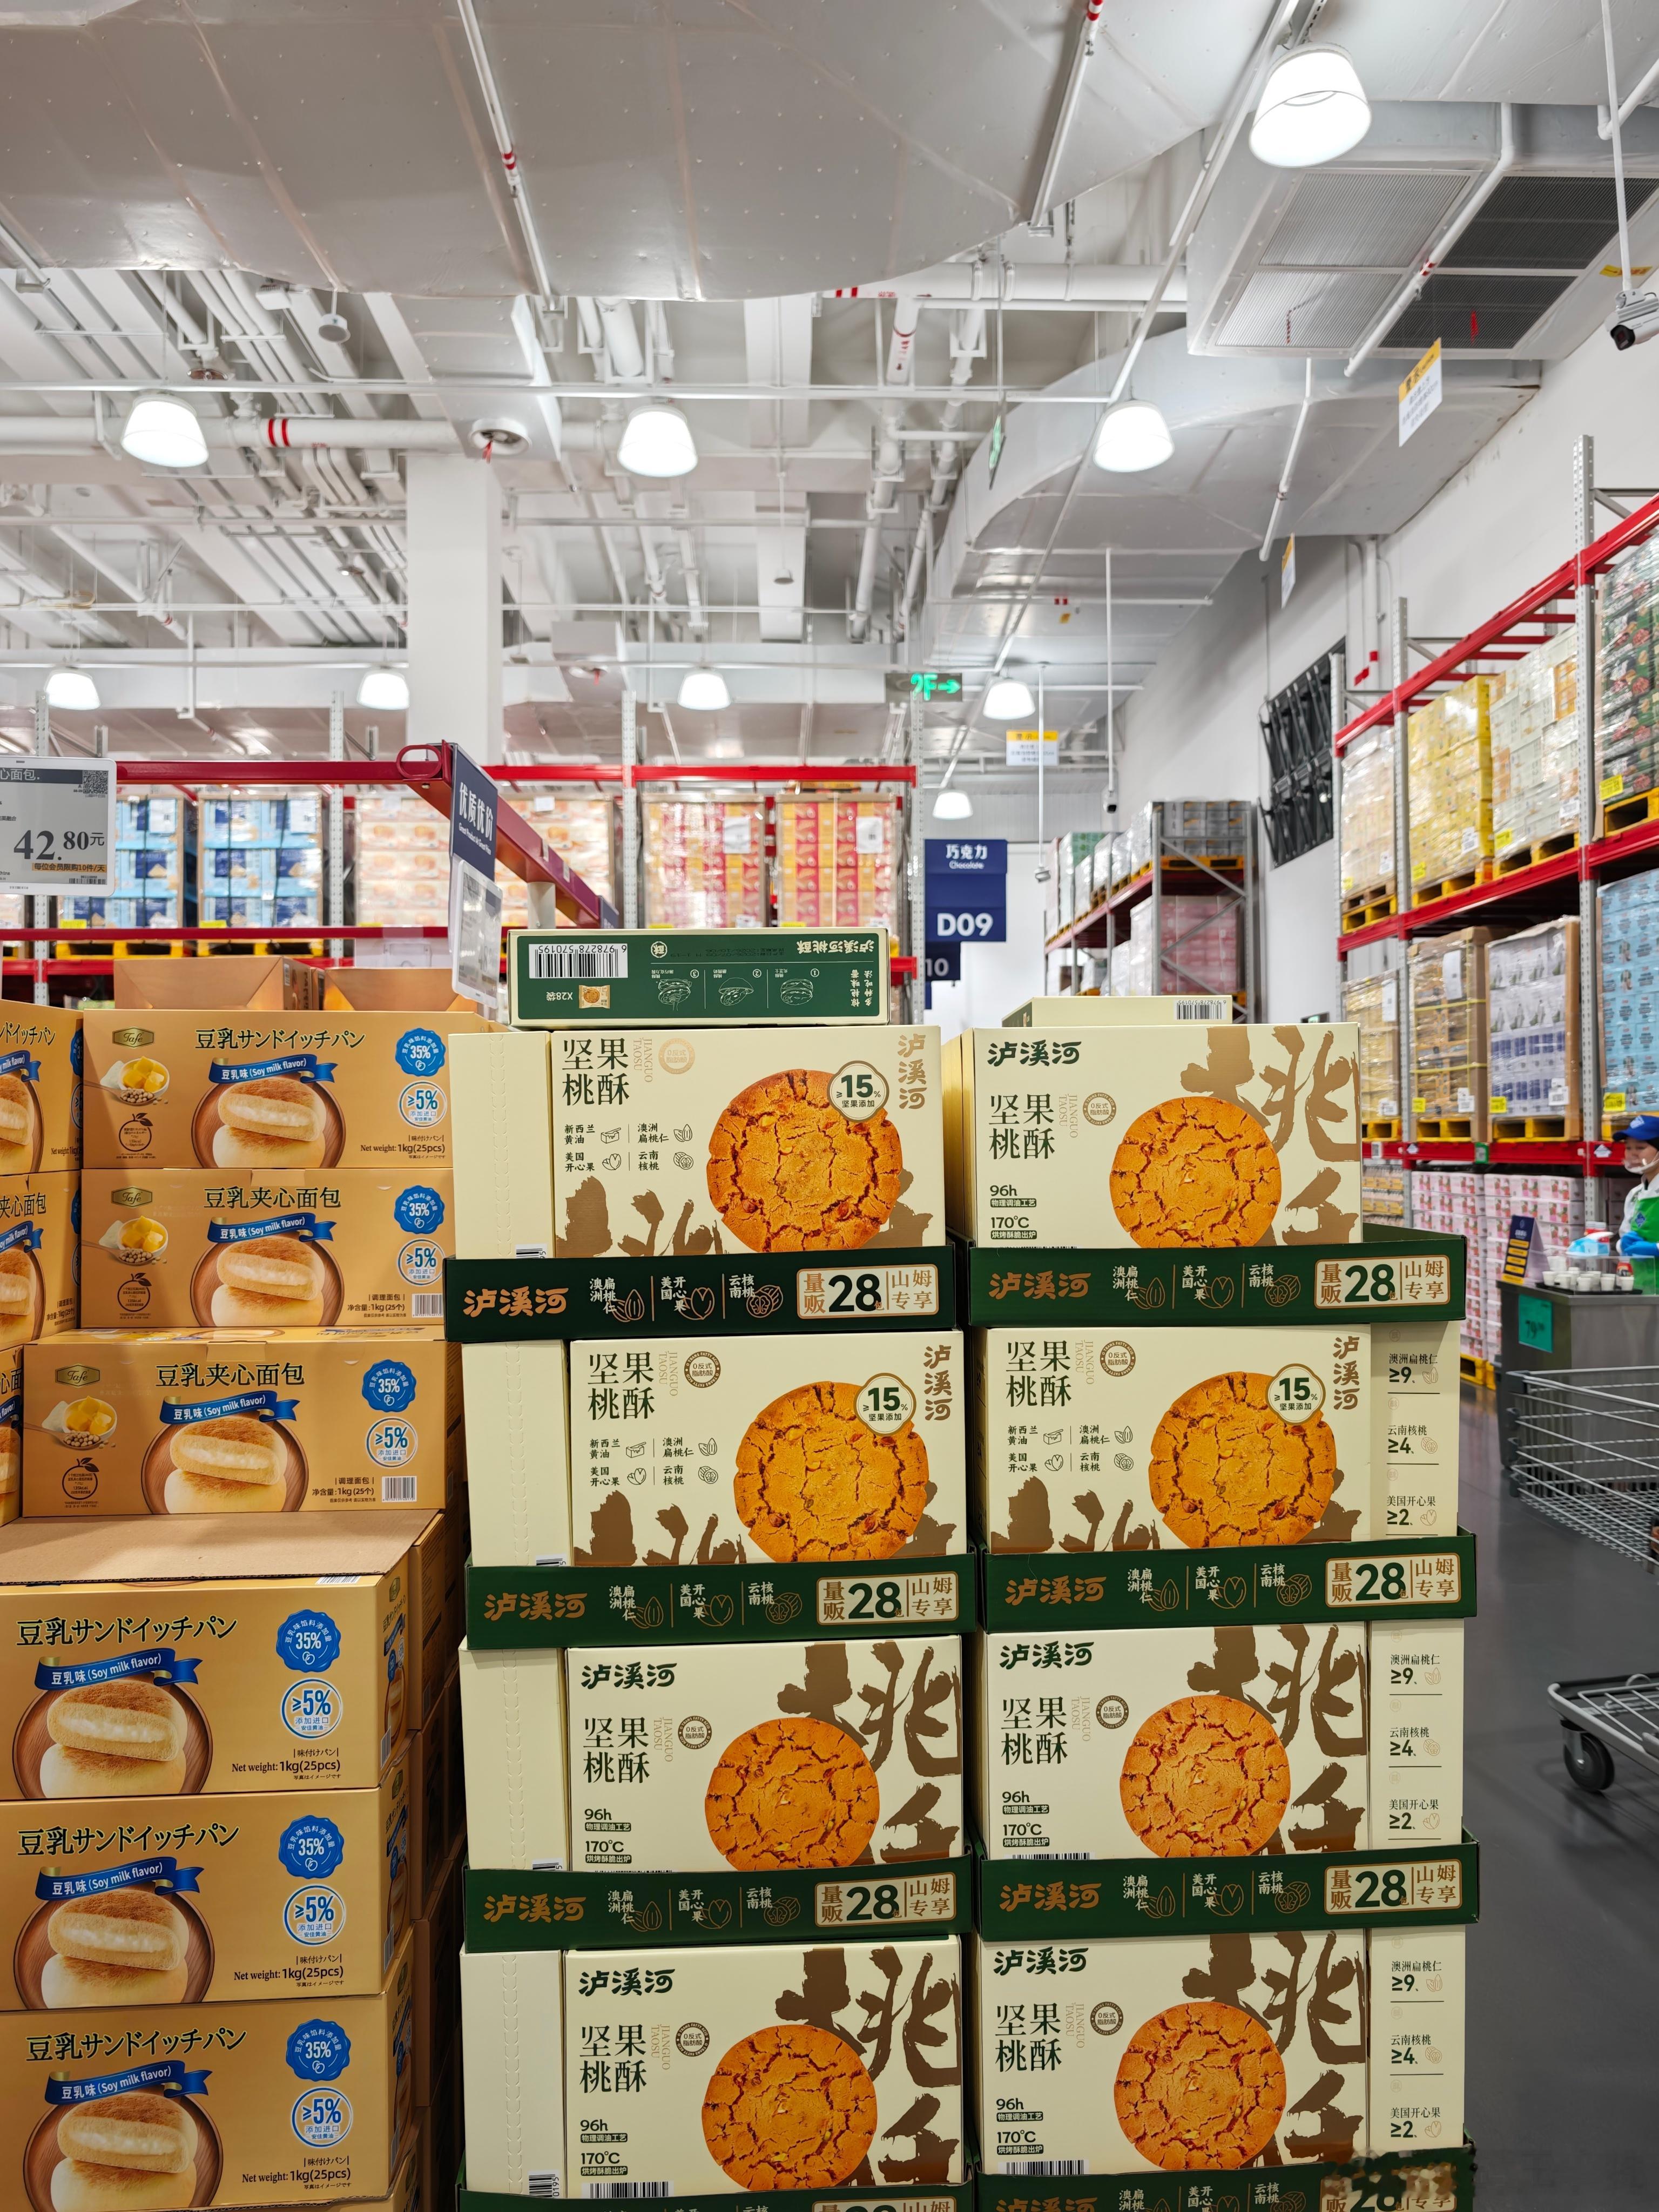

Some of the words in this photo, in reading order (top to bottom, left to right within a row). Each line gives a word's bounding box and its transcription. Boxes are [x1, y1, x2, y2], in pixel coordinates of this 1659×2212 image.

[460, 782, 493, 841] 优质优价
[946, 844, 988, 860] 巧克力
[34, 863, 105, 872] 每位会员限购10件/天
[949, 860, 984, 869] Chocolate
[937, 913, 994, 936] D09
[653, 945, 664, 955] 酥
[797, 940, 874, 954] 泸溪河桃酥
[546, 992, 572, 1001] X28袋
[850, 969, 860, 1007] 惊艳味蕾
[864, 970, 873, 1006] 多种吃法
[194, 1028, 366, 1050] 豆乳サンドイッチパン
[410, 1046, 430, 1059] 35%
[562, 1038, 629, 1071] 坚果
[633, 1038, 642, 1071] TAOSU
[643, 1037, 653, 1083] JIANGUO
[987, 1040, 1082, 1067] 泸溪河
[898, 1034, 927, 1109] 泸溪河
[408, 1090, 438, 1110] ≥5%
[562, 1073, 630, 1107] 桃酥
[842, 1100, 875, 1108] 坚果添加
[989, 1092, 1055, 1127] 坚果
[373, 1144, 396, 1154] weight:
[398, 1144, 445, 1154] 1kg(25pcs)
[989, 1127, 1055, 1161] 桃酥
[203, 1186, 341, 1210] 豆乳夹心面包
[989, 1184, 1017, 1198] 96h
[991, 1199, 1036, 1207] 物理调油工艺
[409, 1203, 430, 1216] 35%
[991, 1230, 1037, 1239] 烘烤酥脆出炉
[892, 1270, 932, 1290] 山姆
[989, 1271, 1091, 1300] 泸溪河
[1345, 1264, 1395, 1303] 28
[462, 1285, 569, 1318] 泸溪河
[804, 1273, 825, 1315] 量贩
[828, 1273, 881, 1313] 28
[892, 1292, 933, 1311] 专享
[659, 1351, 667, 1385] TAOSU
[1005, 1339, 1071, 1373] 坚果
[1388, 1353, 1439, 1365] 澳洲扁桃仁
[154, 1361, 305, 1387] 豆乳夹心面包
[588, 1352, 654, 1385] 坚果
[667, 1351, 678, 1396] JIANGUO
[1333, 1335, 1360, 1411] 泸溪河
[378, 1378, 400, 1393] 35%
[923, 1345, 953, 1422] 泸溪河
[1005, 1373, 1072, 1407] 桃酥
[173, 1407, 203, 1421] 豆乳味
[204, 1405, 221, 1419] (Soy
[222, 1399, 238, 1413] milk
[239, 1395, 266, 1410] flavor)
[588, 1387, 655, 1420] 桃酥
[868, 1413, 902, 1422] 坚果添加
[375, 1427, 408, 1448] ≥5%
[663, 1437, 683, 1447] 澳洲
[1387, 1424, 1427, 1437] 云南核桃
[589, 1439, 621, 1448] 新西兰
[589, 1449, 609, 1459] 黄油
[663, 1447, 694, 1458] 扁桃仁
[590, 1466, 609, 1476] 美国
[663, 1465, 683, 1474] 云南
[663, 1476, 684, 1486] 核桃
[590, 1477, 620, 1487] 开心果
[1386, 1494, 1437, 1508] 美国开心果
[1355, 1562, 1406, 1602] 28
[484, 1591, 588, 1622] 泸溪河
[847, 1582, 901, 1620] 28
[16, 1615, 239, 1647] 豆乳サンドイッチパン
[285, 1619, 332, 1643] 豆乳味馅料添加量
[295, 1632, 321, 1650] 35%
[999, 1640, 1095, 1670] 泸溪河
[1391, 1654, 1440, 1665] 澳洲扁桃仁
[51, 1670, 86, 1686] 豆乳味
[87, 1668, 109, 1683] (Soy
[110, 1661, 129, 1676] milk
[131, 1653, 161, 1672] flavor)
[581, 1661, 678, 1690] 泸溪河
[292, 1689, 331, 1716] ≥5%
[1390, 1727, 1429, 1738] 云南核桃
[232, 1763, 246, 1772] Net
[248, 1762, 278, 1773] weight:
[280, 1760, 340, 1773] 1kg(25pcs)
[584, 1808, 612, 1820] 96h
[1388, 1799, 1439, 1810] 美国开心果
[17, 1821, 240, 1858] 豆乳サンドイッチパン
[294, 1896, 334, 1923] ≥5%
[993, 1946, 1089, 1975] 泸溪河
[577, 1967, 676, 1998] 泸溪河
[25, 2027, 247, 2063] 豆乳サンドイッチパン
[305, 2125, 340, 2134] 添加进口
[242, 2173, 257, 2183] Net
[259, 2171, 289, 2184] weight:
[289, 2168, 352, 2184] 1kg(25pcs)
